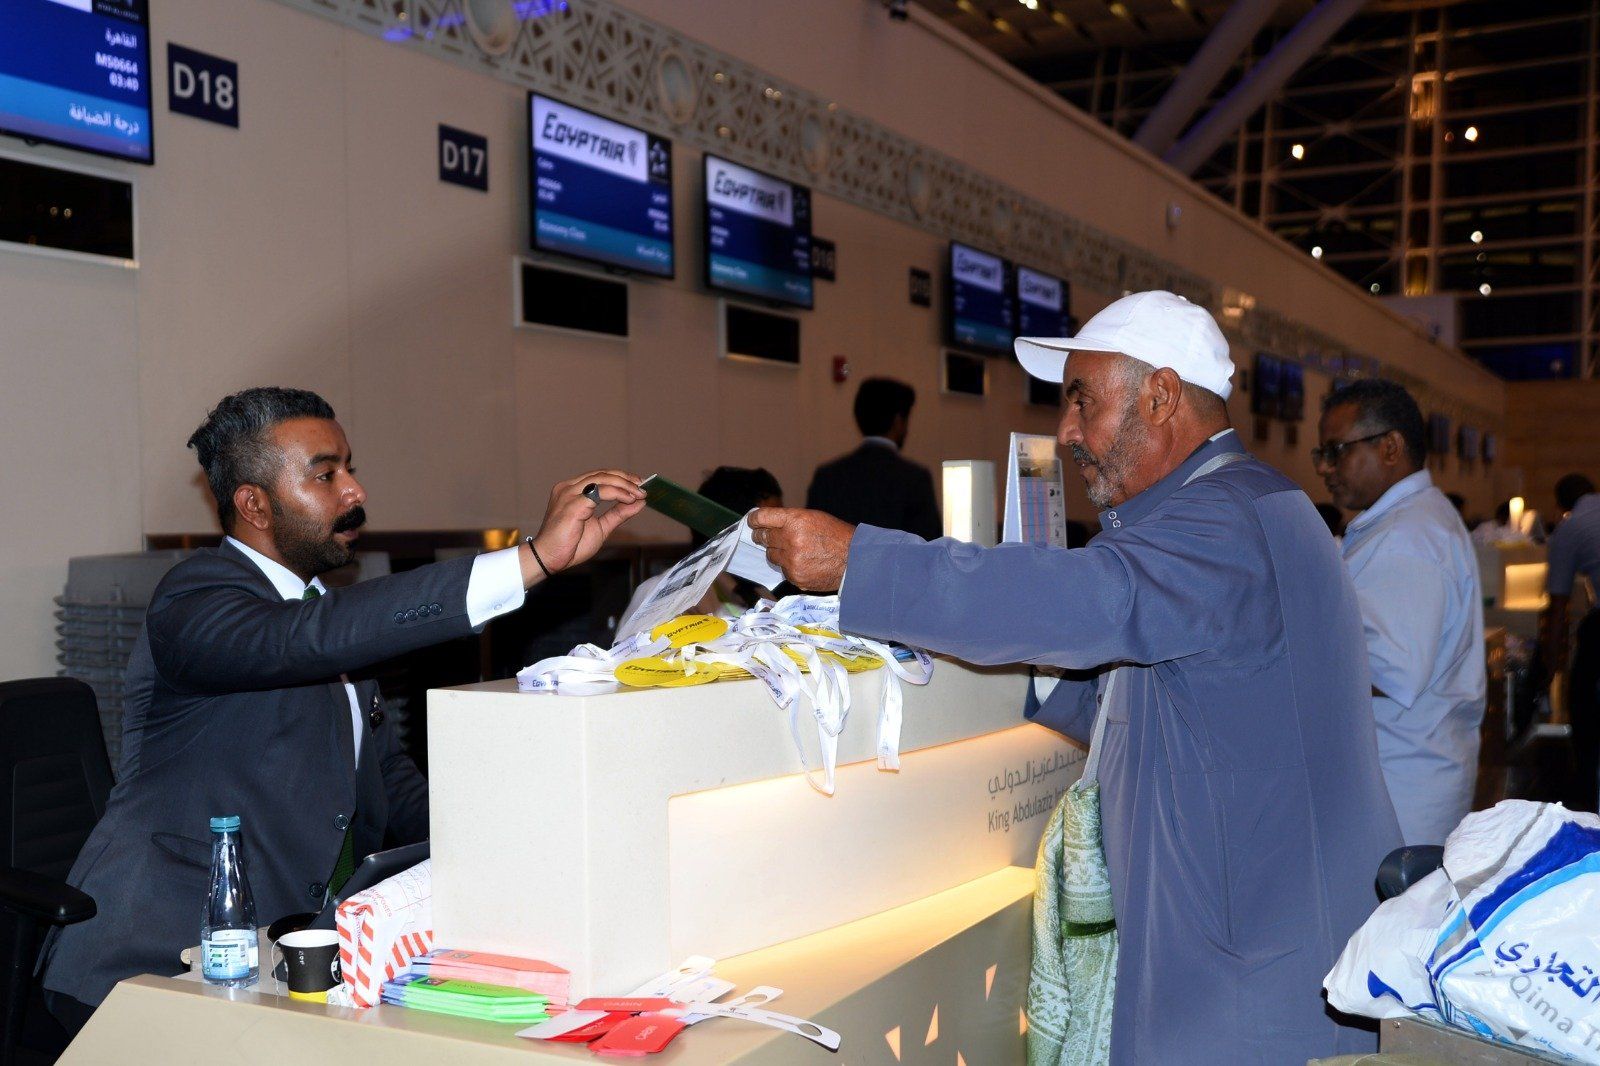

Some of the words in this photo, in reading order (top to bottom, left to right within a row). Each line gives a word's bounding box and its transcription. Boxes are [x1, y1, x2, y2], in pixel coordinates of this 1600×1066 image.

[173, 62, 234, 110] D18
[443, 140, 485, 176] D17
[542, 113, 625, 161] EGYPTAIR
[665, 619, 704, 638] GYPTAIR
[988, 761, 1030, 800] الدولي
[988, 810, 1010, 833] King
[1013, 791, 1053, 824] Abdulaziz
[1509, 974, 1574, 1034] Qima
